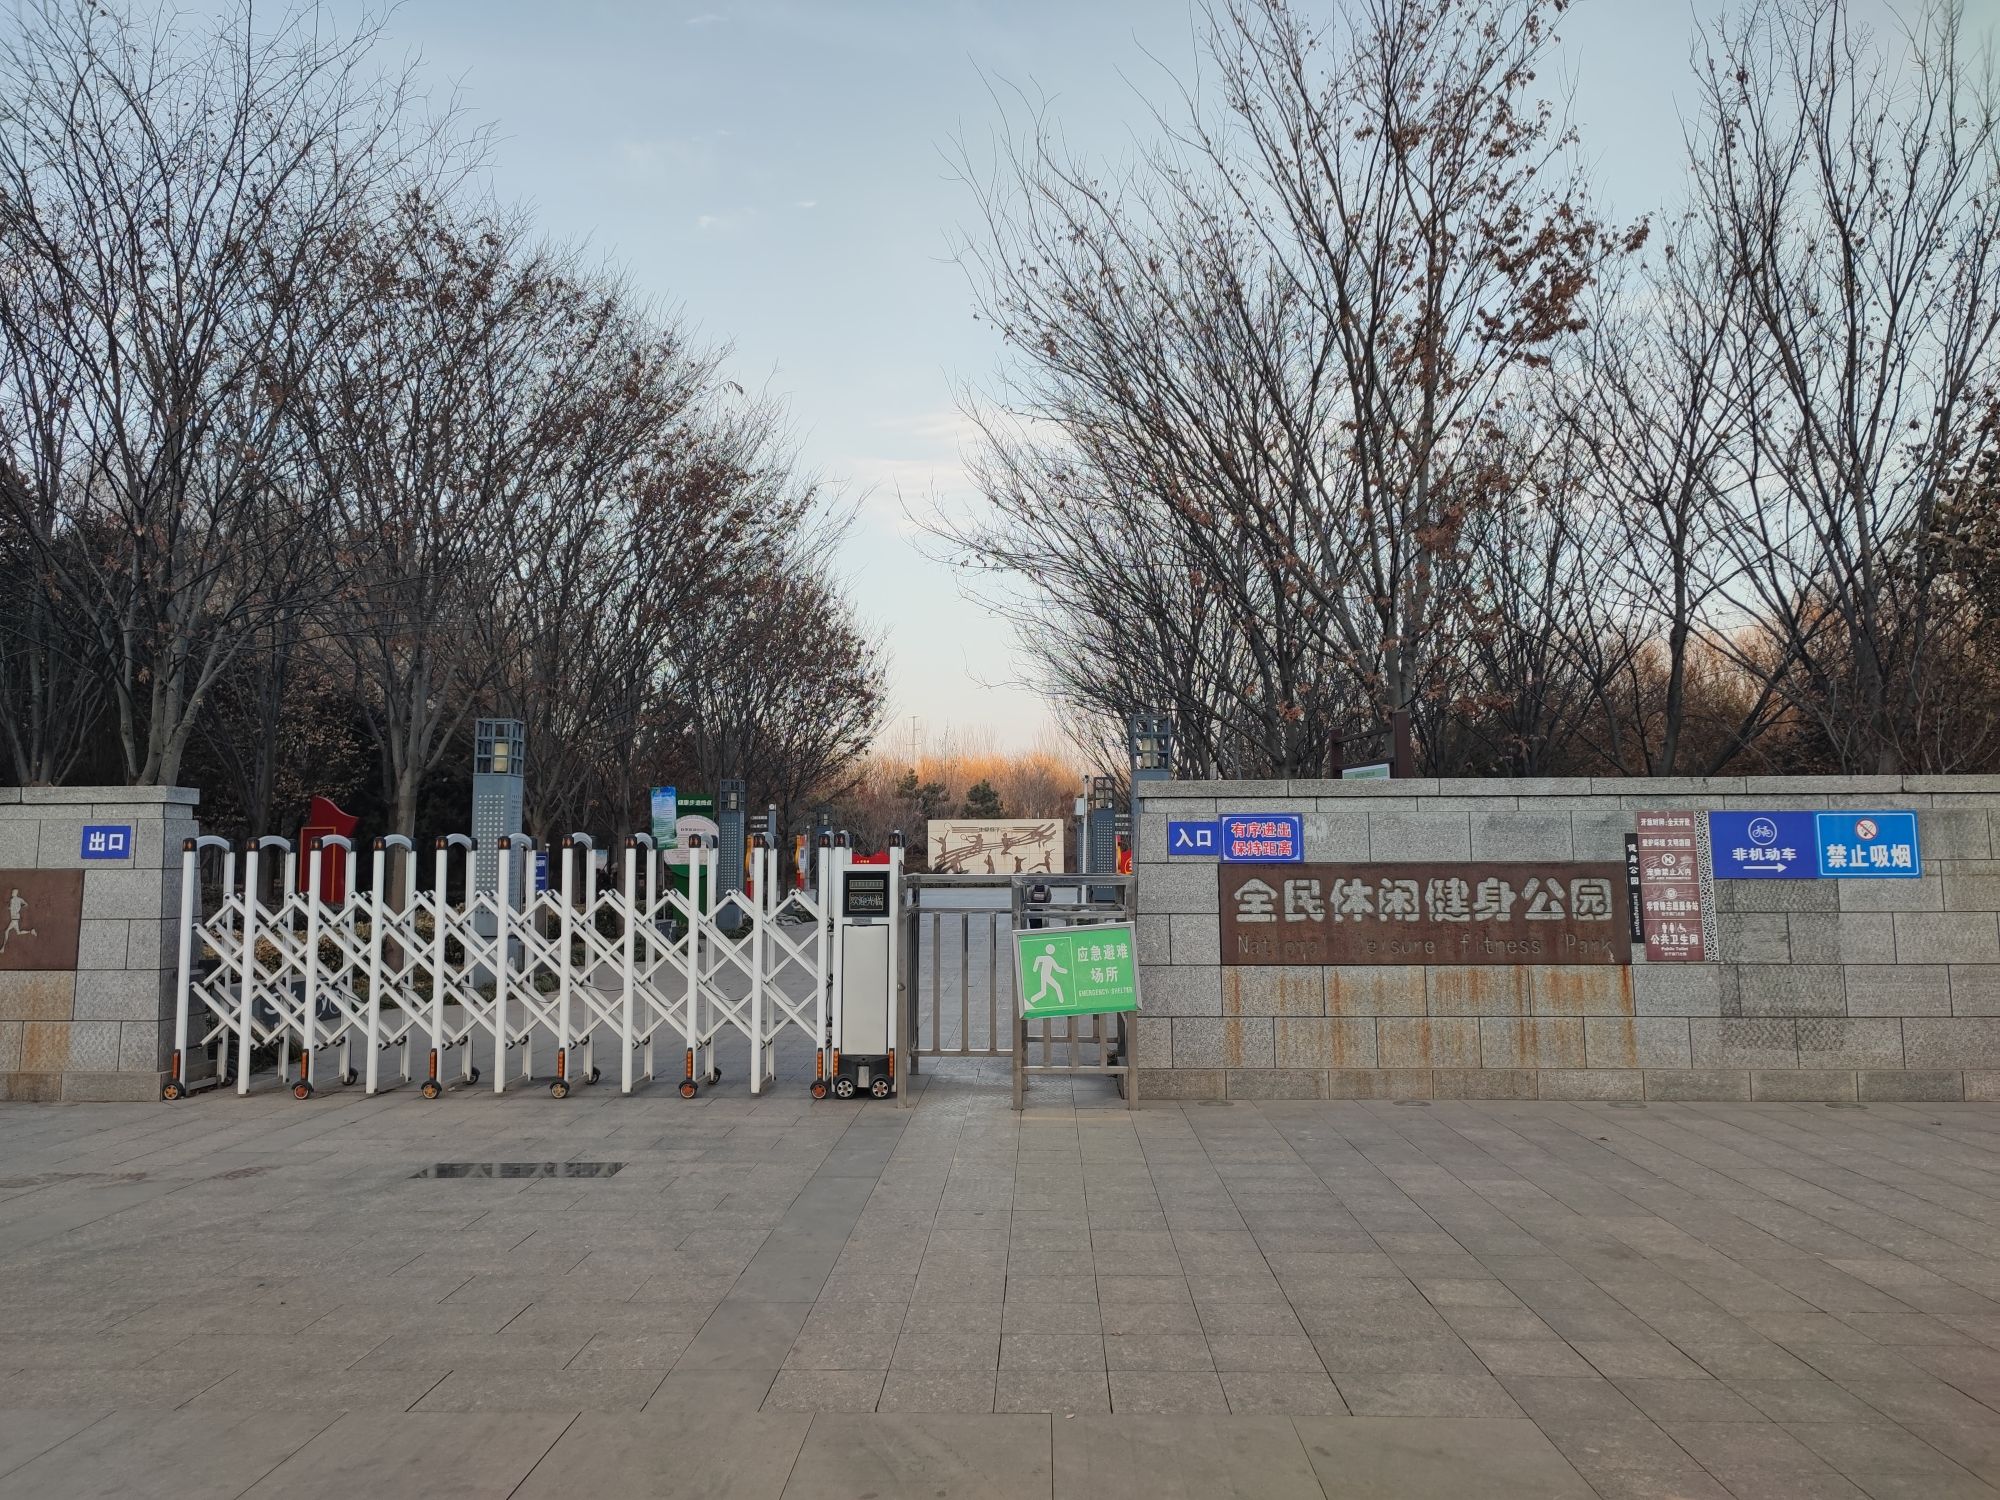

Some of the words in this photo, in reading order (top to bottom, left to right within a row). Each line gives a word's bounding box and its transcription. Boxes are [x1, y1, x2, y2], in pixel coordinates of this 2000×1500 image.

[1175, 828, 1211, 847] 入口
[1231, 822, 1292, 838] 有序进出
[89, 832, 123, 851] 出口
[1232, 840, 1292, 857] 保持距离
[1732, 847, 1797, 862] 非机动车
[1826, 843, 1912, 868] 禁止吸烟
[1627, 843, 1640, 885] 健身公园
[1646, 868, 1692, 876] 宠物禁止入内
[1233, 877, 1613, 923] 全民休闲健身公园
[1651, 933, 1699, 945] 公共卫生间
[1078, 944, 1128, 962] 应急避难
[1091, 966, 1118, 983] 场所
